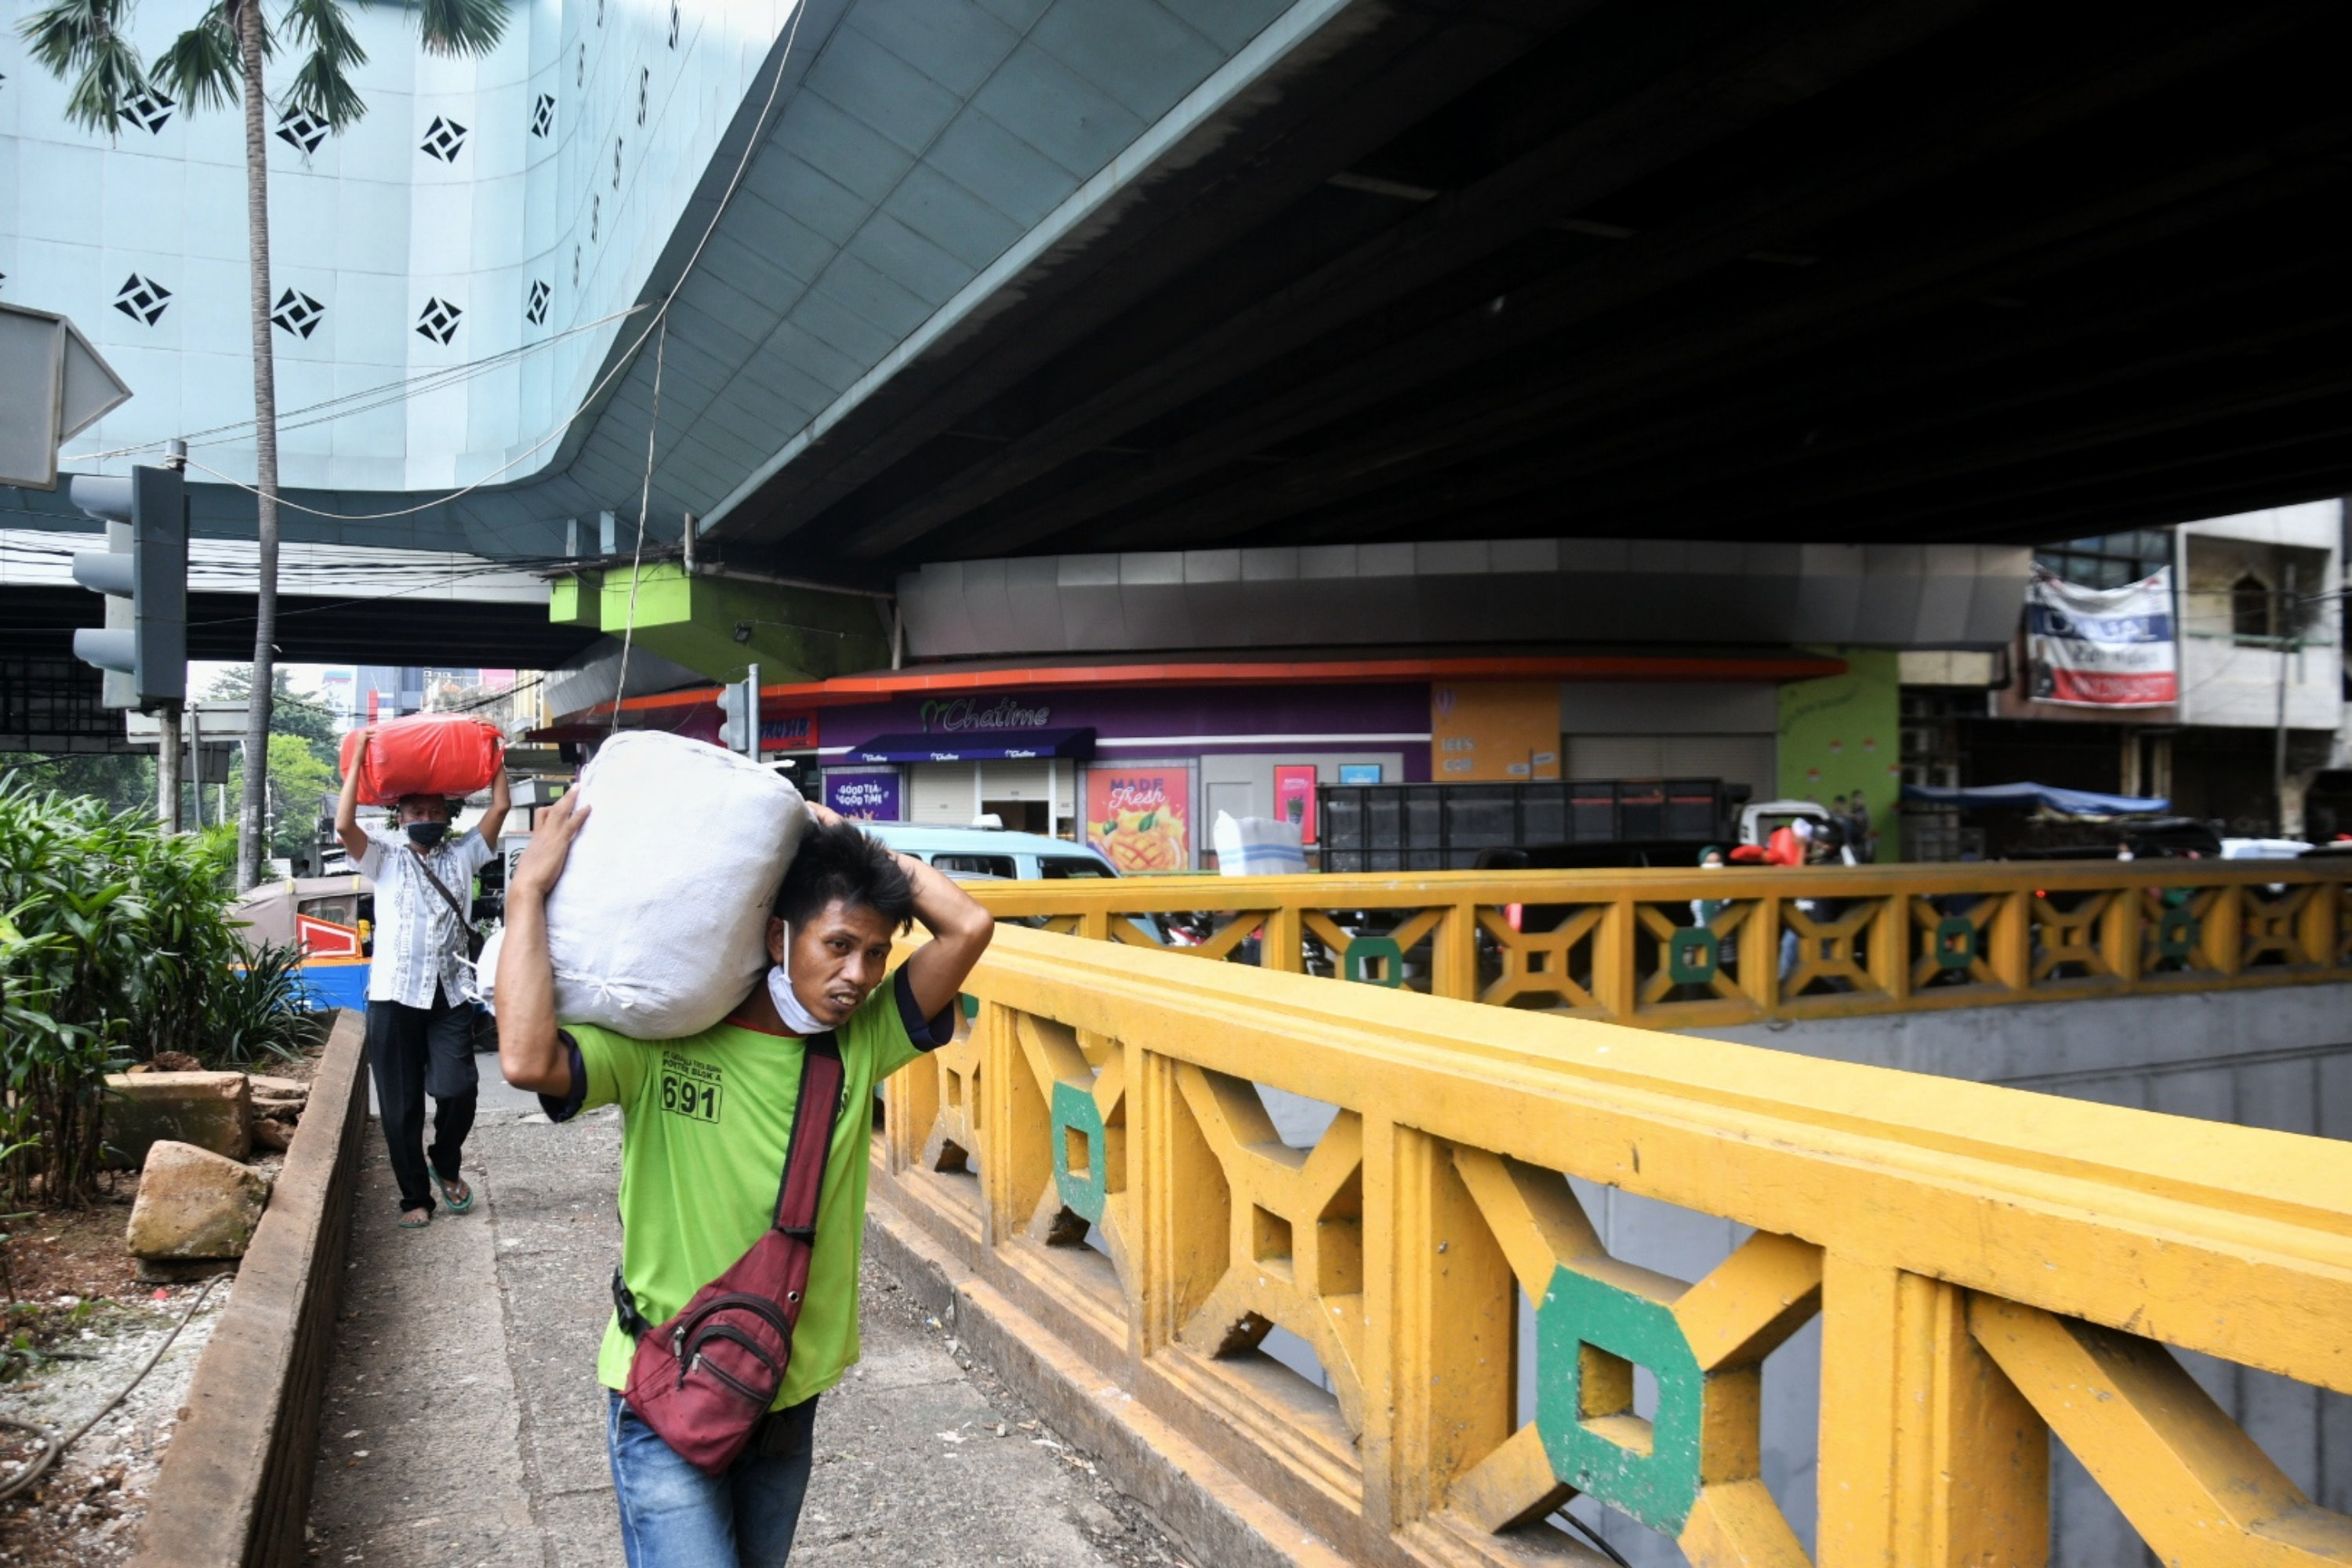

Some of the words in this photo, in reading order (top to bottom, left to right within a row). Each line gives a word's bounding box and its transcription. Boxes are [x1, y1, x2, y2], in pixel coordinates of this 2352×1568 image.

[943, 697, 1051, 731] Chatime
[840, 785, 863, 795] GOOD
[864, 784, 878, 794] TEA
[1110, 778, 1163, 792] MADE
[838, 794, 863, 805] GOOD
[864, 794, 882, 804] TIME
[1109, 786, 1166, 808] Fresh
[662, 1058, 689, 1075] PORTER
[691, 1067, 713, 1080] BLOK
[663, 1076, 714, 1119] 691
